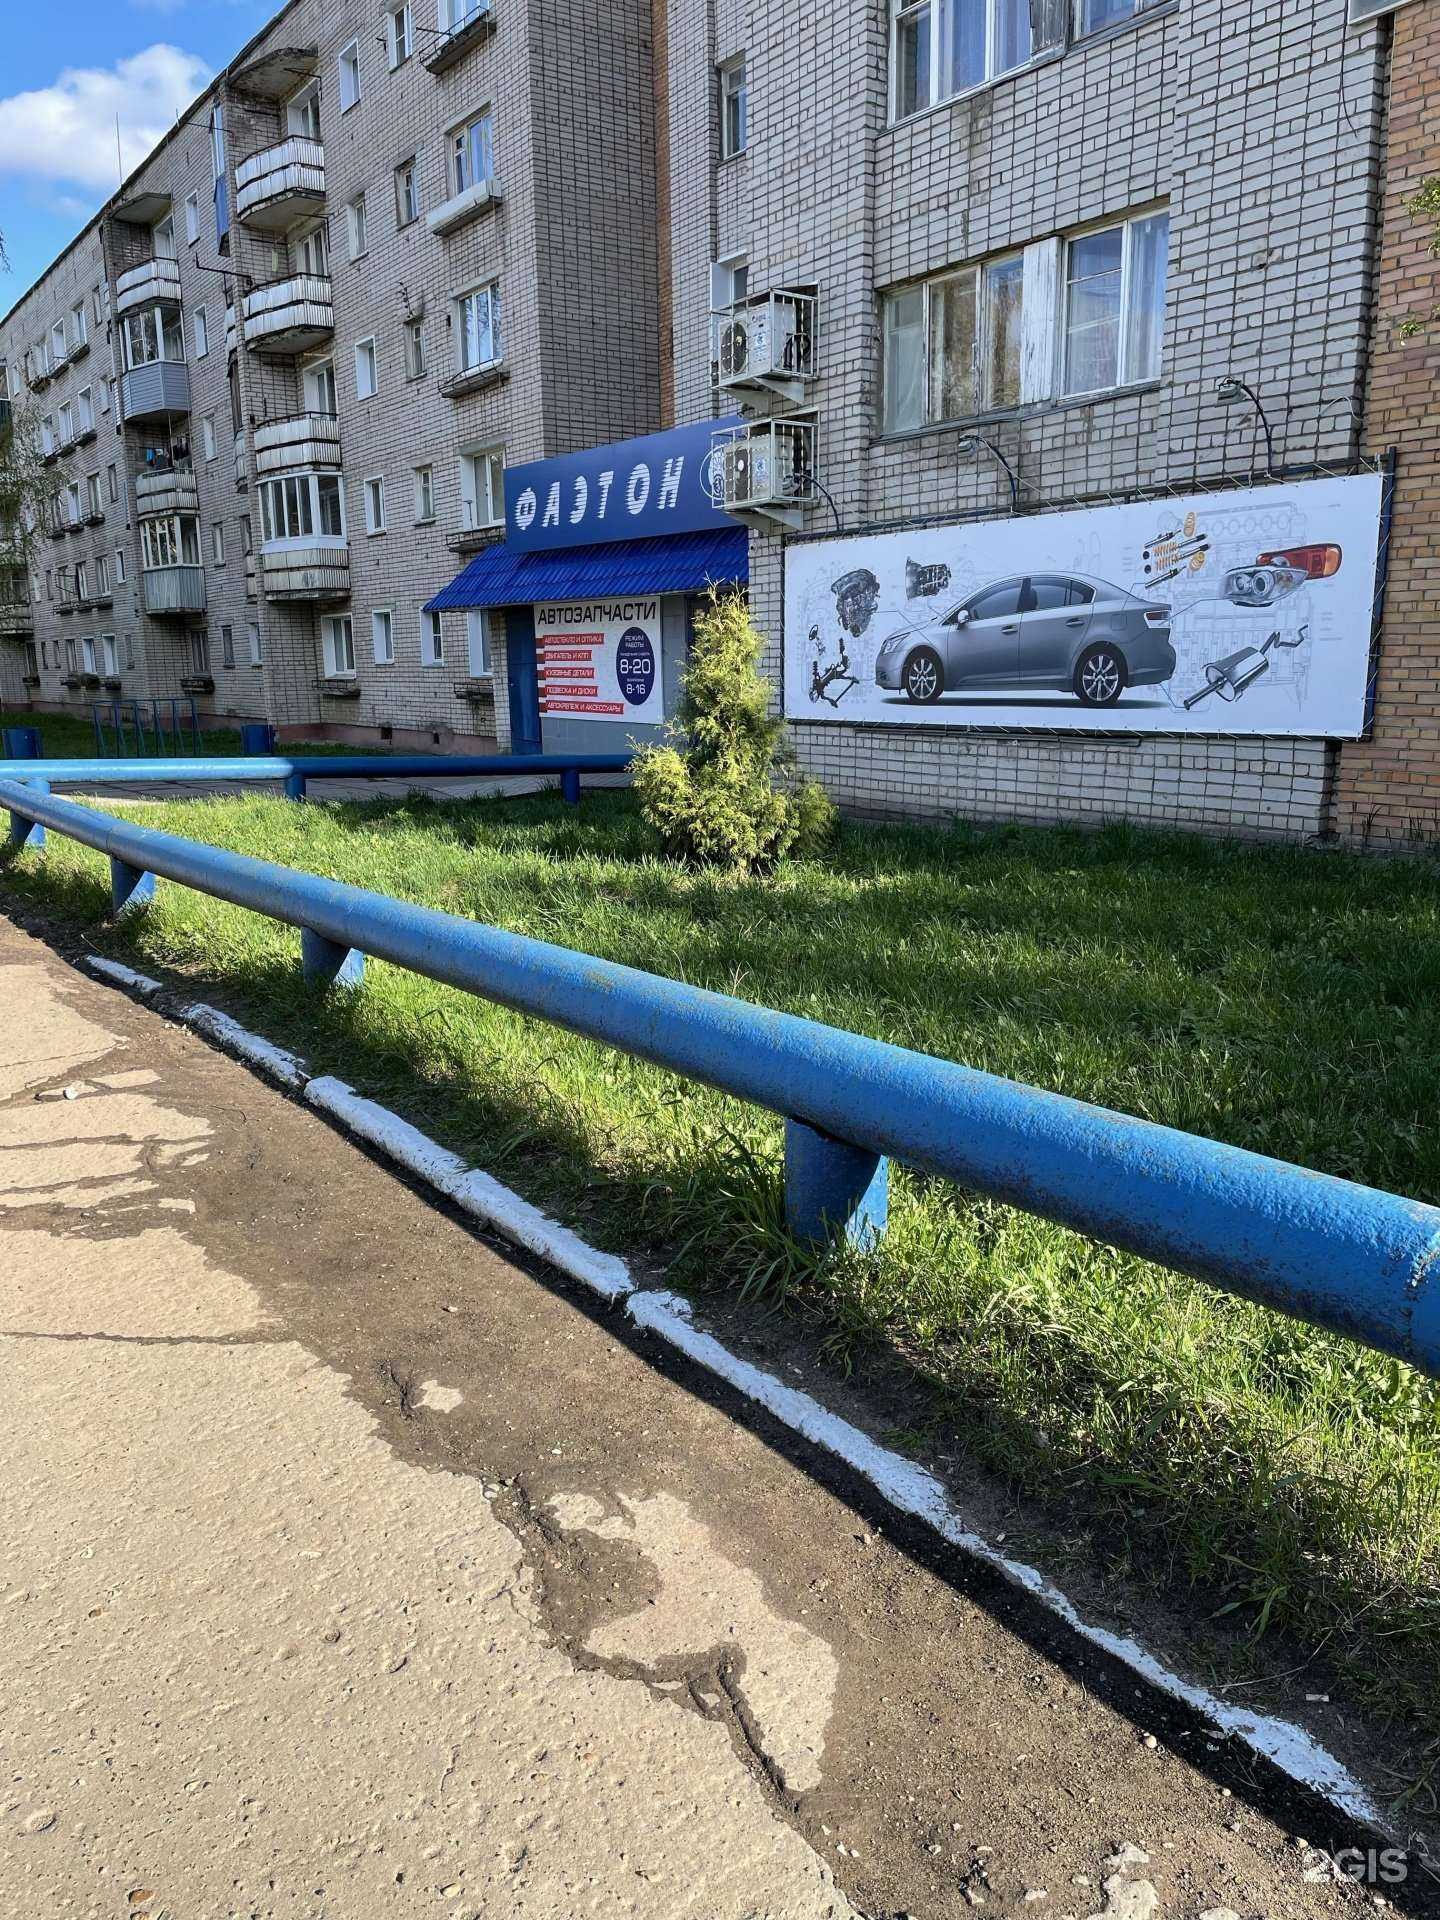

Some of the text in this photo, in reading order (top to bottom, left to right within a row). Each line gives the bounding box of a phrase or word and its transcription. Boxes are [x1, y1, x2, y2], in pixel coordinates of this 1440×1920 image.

[514, 456, 685, 531] ФАЭТОН
[538, 602, 657, 625] АВТОЗАПЧАСТИ
[620, 658, 651, 674] 8-20
[577, 687, 596, 695] ДИСКИ
[626, 683, 646, 695] 8-16
